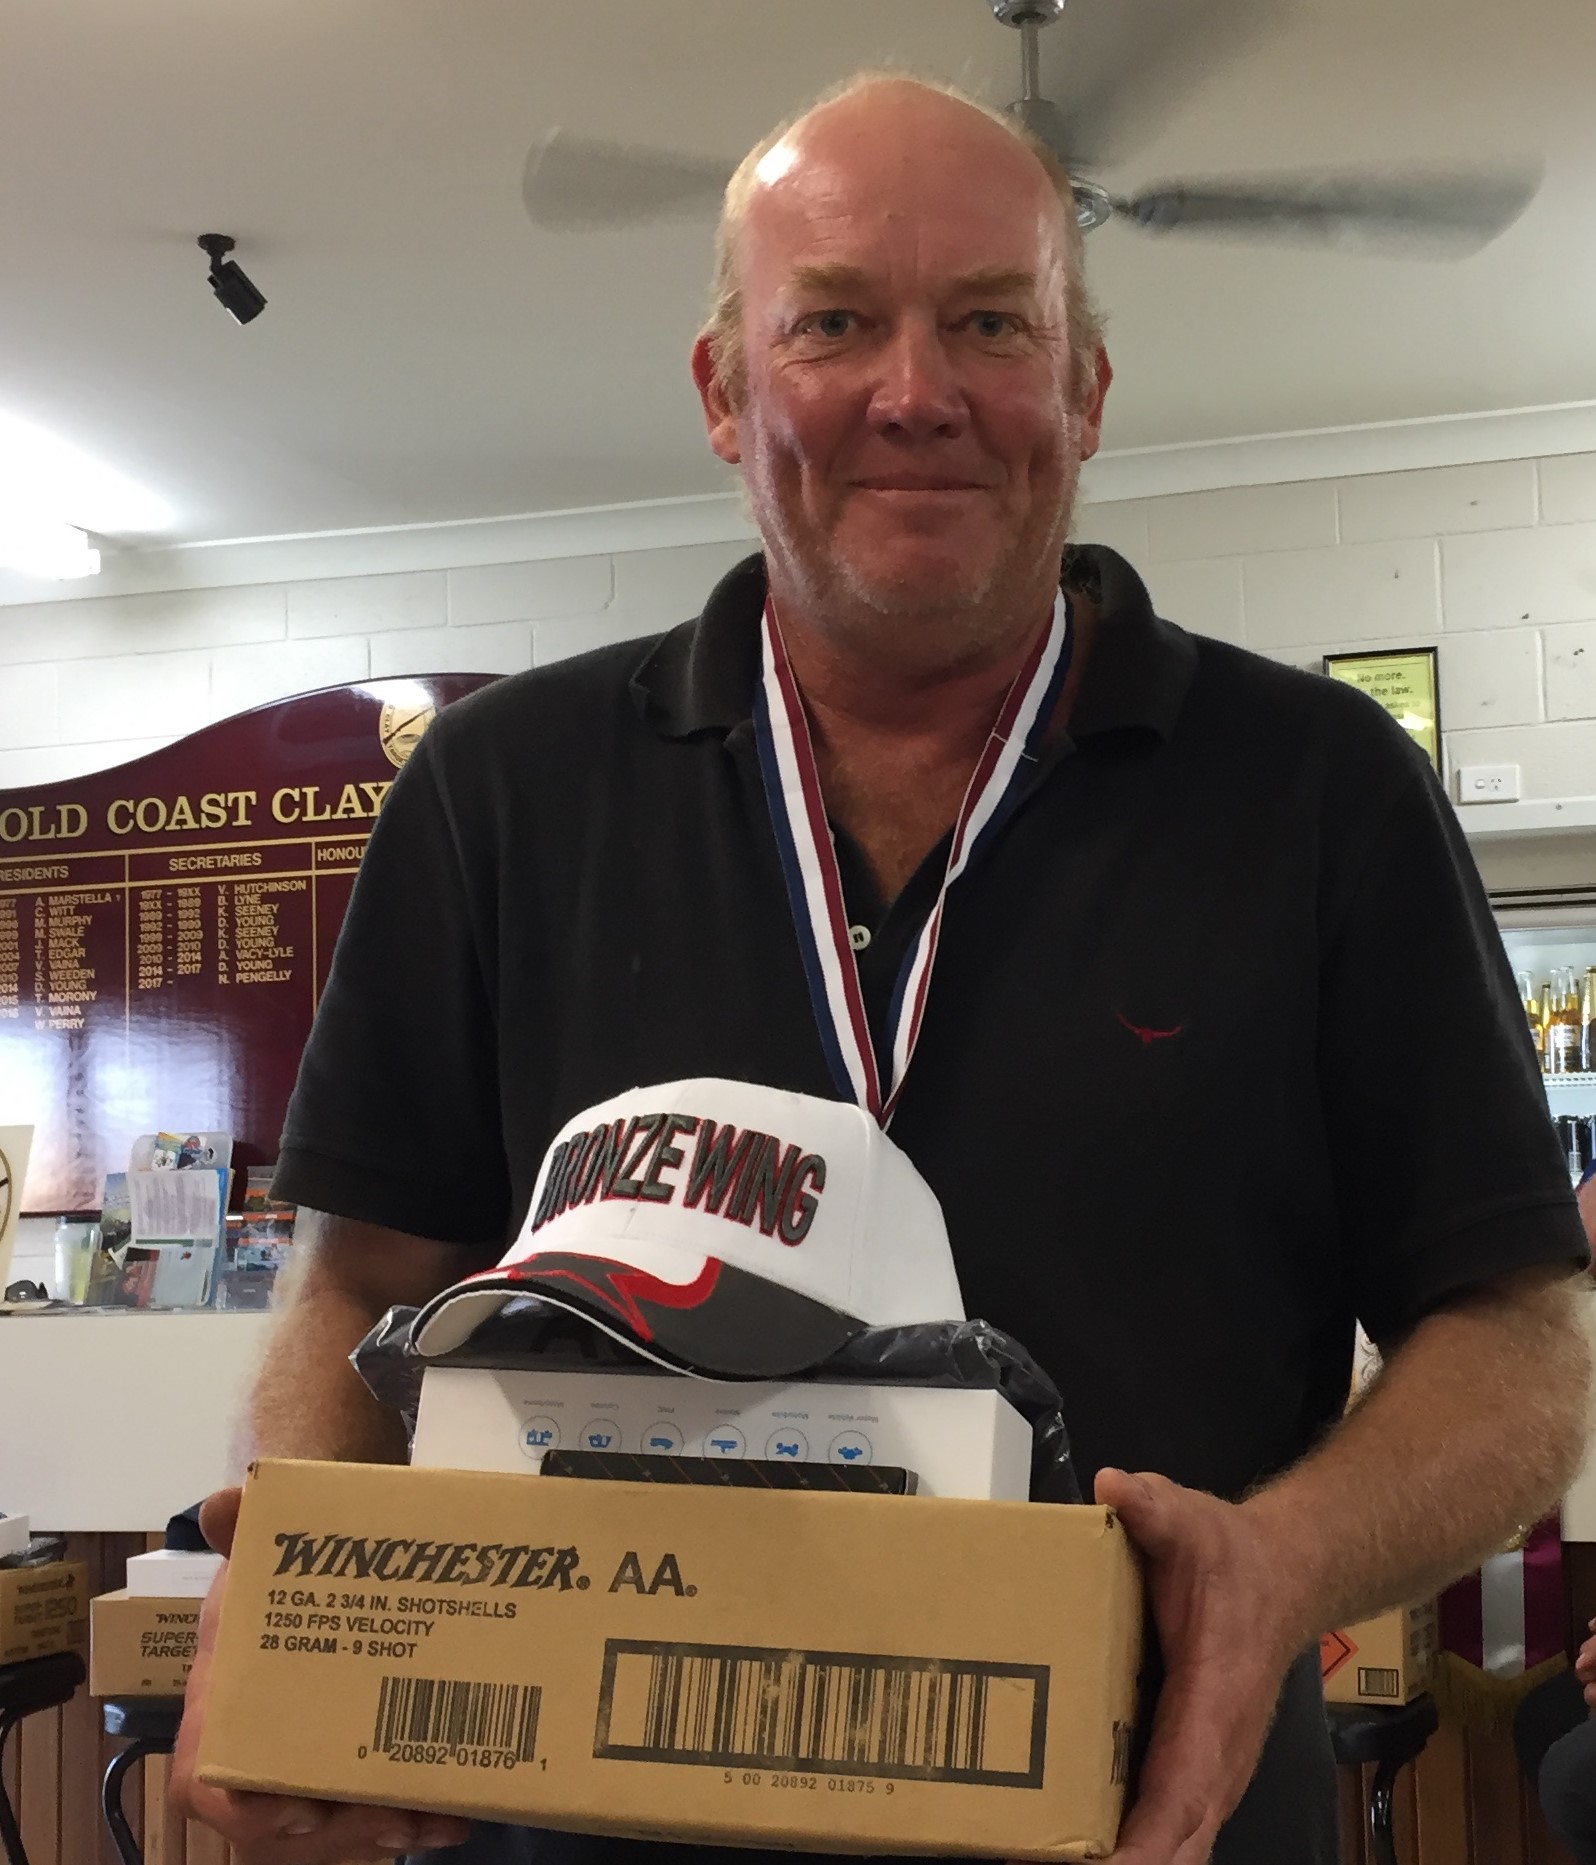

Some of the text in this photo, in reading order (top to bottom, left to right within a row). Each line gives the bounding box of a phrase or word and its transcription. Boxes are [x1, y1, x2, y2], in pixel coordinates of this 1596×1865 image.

[1375, 672, 1406, 682] more.
[1370, 686, 1413, 696] the law.
[107, 791, 256, 835] COAST
[272, 782, 394, 824] CLAY
[169, 852, 262, 872] SECRETARIES
[234, 880, 306, 894] HUTCHINSON
[234, 894, 261, 905] LYNE
[49, 905, 76, 917] WITT
[235, 904, 279, 916] SEENEY
[48, 915, 93, 927] MURPHY
[235, 915, 274, 927] YOUNG
[235, 926, 279, 938] SEENEY
[49, 938, 80, 949] MACK
[235, 937, 275, 948] YOUNG
[49, 948, 86, 960] EDGAR
[177, 952, 201, 962] 2014
[235, 946, 294, 960] VACY-LYLE
[49, 968, 96, 980] WEEDEN
[139, 966, 163, 976] 2014
[177, 964, 201, 975] 2017
[236, 960, 274, 971] YOUNG
[138, 978, 163, 989] 2017
[236, 970, 292, 984] PENGELLY
[49, 980, 87, 992] YOUNG
[48, 991, 98, 1003] MORONY
[49, 1018, 85, 1030] PERRY
[267, 1590, 517, 1619] 12 GA. 2 3/4 IN. SHOTSHELLS
[264, 1612, 435, 1636] 1250 FPS VELOCITY
[260, 1635, 279, 1651] 28
[284, 1636, 338, 1654] GRAM
[352, 1640, 363, 1655] 9
[367, 1641, 418, 1658] SHOT
[357, 1743, 547, 1771] 0 20892 01876 1
[723, 1770, 895, 1796] 5 00 20892 01875 9
